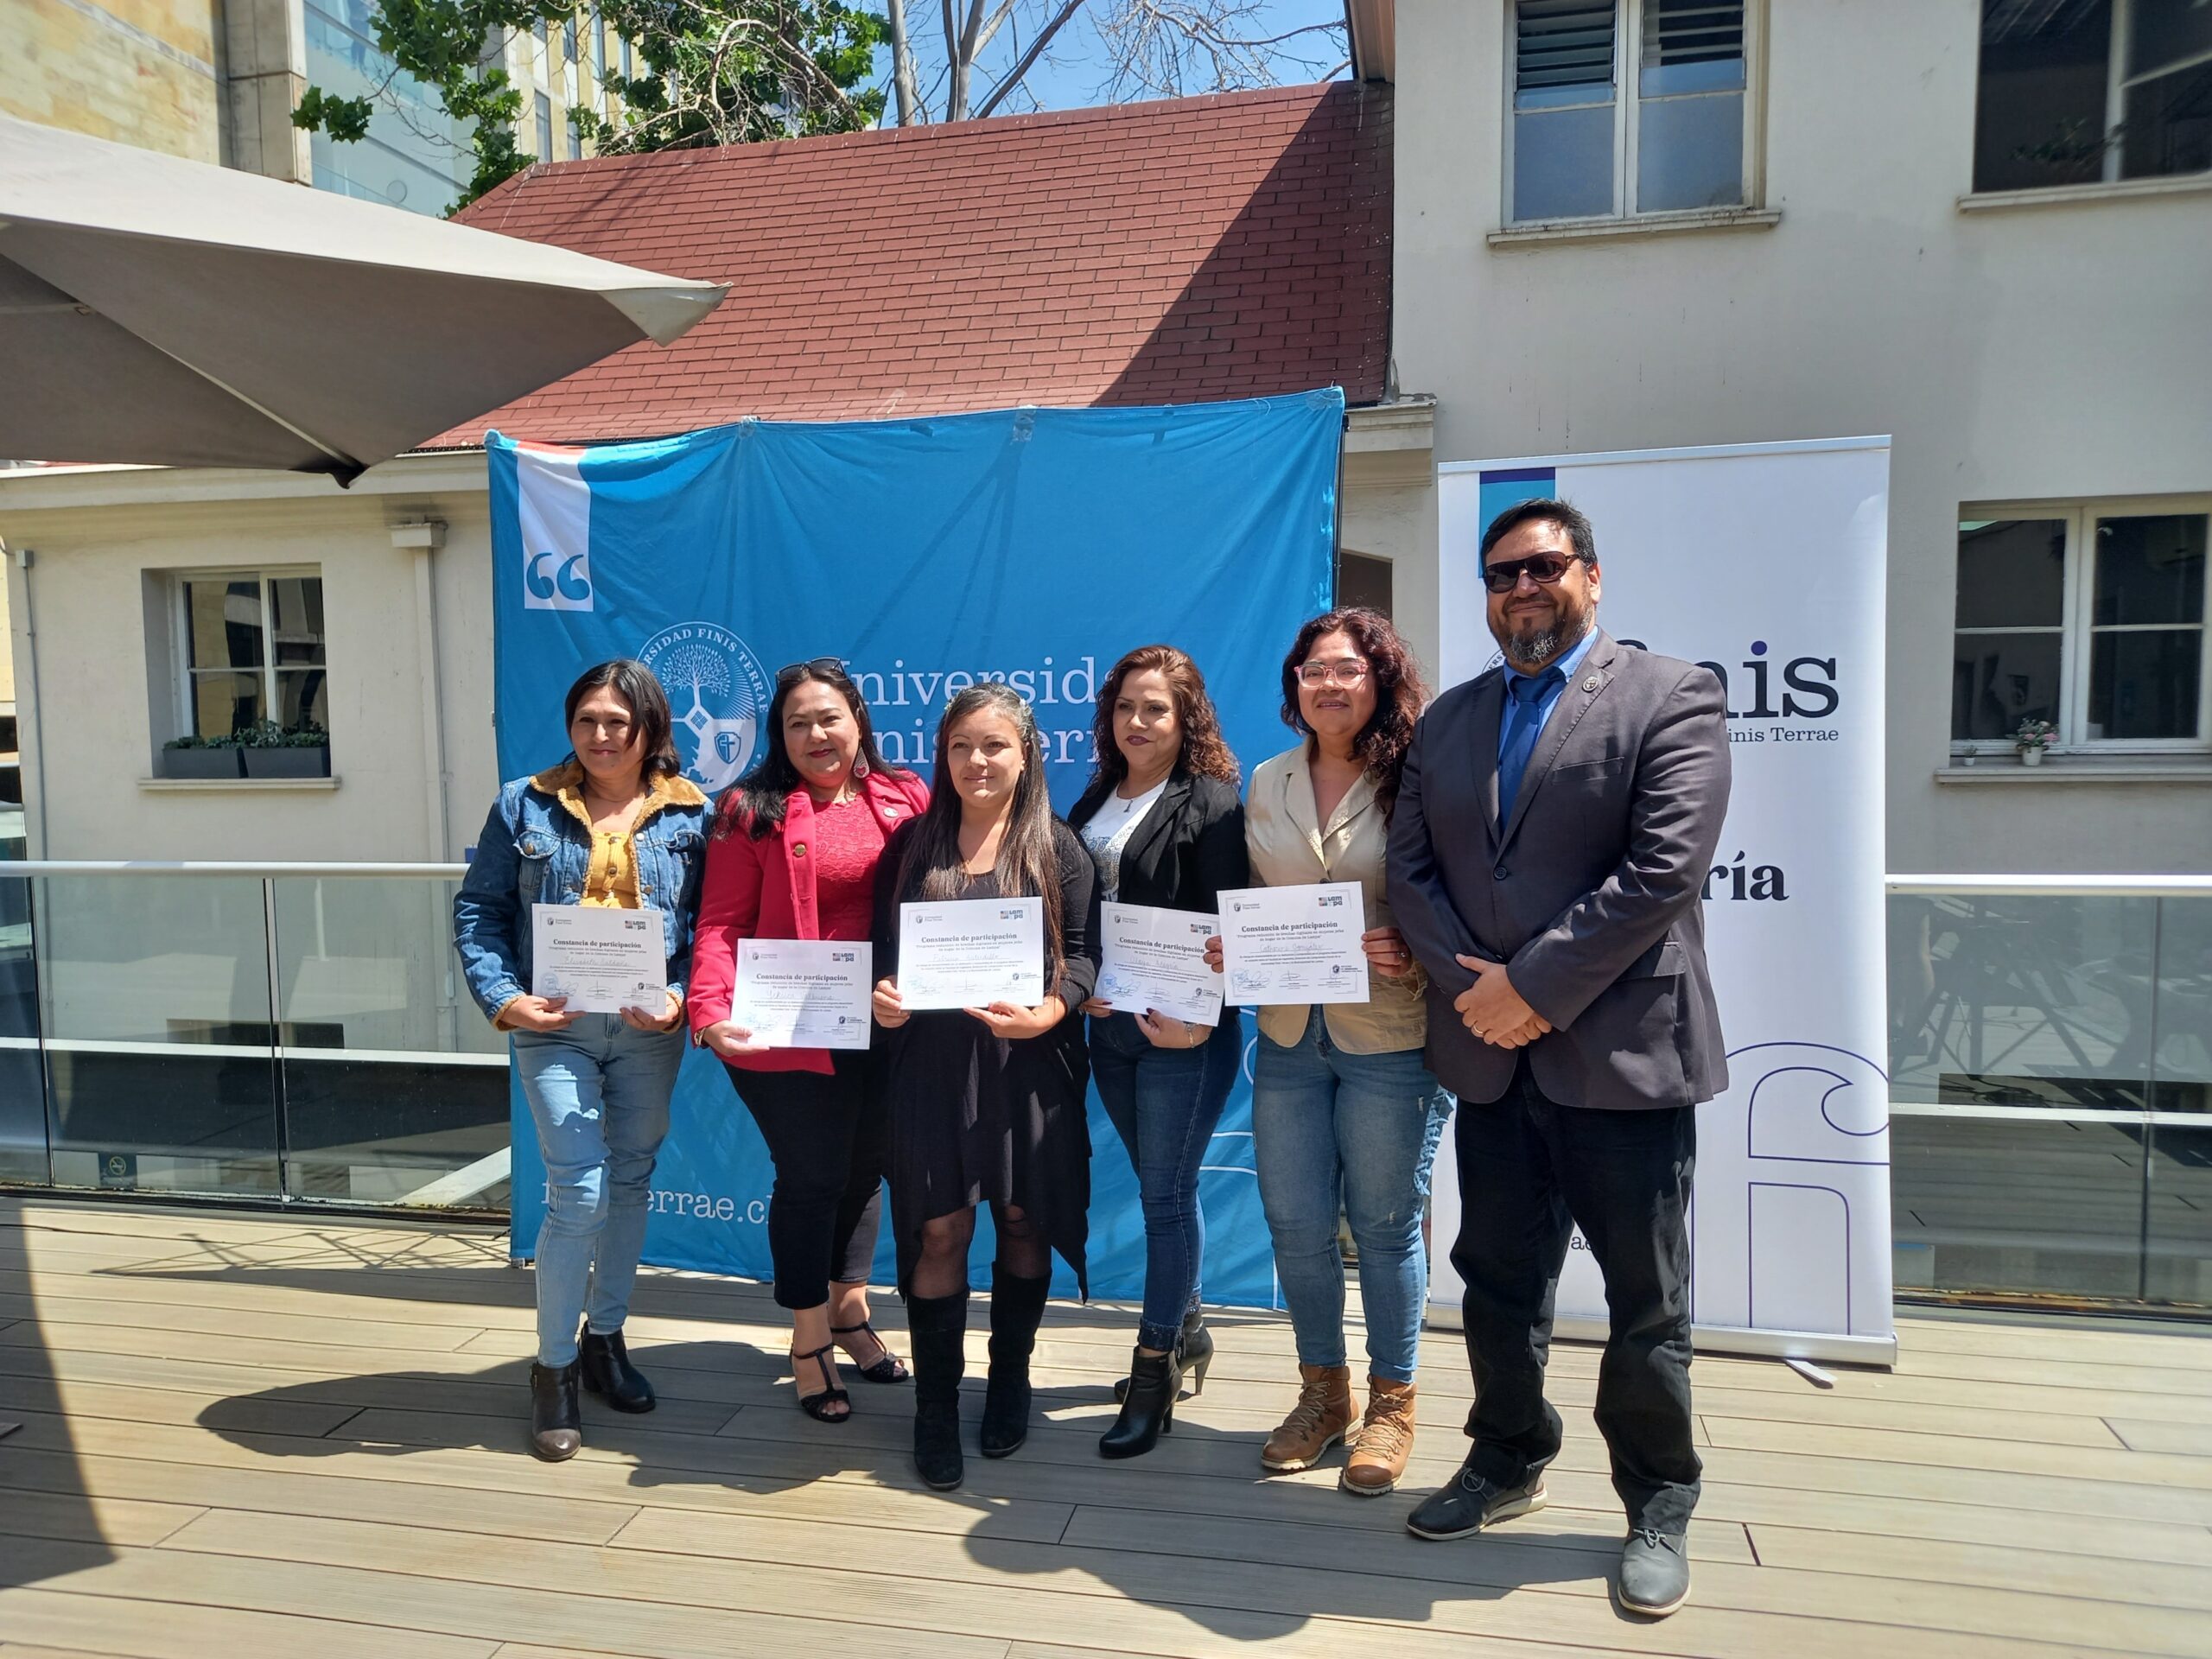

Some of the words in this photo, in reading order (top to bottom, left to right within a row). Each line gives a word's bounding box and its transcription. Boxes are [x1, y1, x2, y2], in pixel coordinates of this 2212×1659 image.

[697, 627, 737, 652] FINIS
[738, 651, 769, 713] TERRAE
[840, 656, 1111, 706] niversid
[1728, 728, 1765, 742] inis
[1770, 727, 1839, 741] Terrae
[1700, 849, 1790, 901] ría
[1241, 924, 1280, 933] Constancia
[1290, 920, 1338, 931] participación
[553, 938, 588, 947] Constancia
[599, 940, 642, 950] participación
[921, 935, 960, 944] Constancia
[970, 932, 1018, 943] participación
[1119, 937, 1154, 948] Constancia
[1154, 940, 1162, 949] de
[1163, 942, 1205, 955] participación
[756, 973, 793, 982] Constancia
[804, 974, 849, 982] participación
